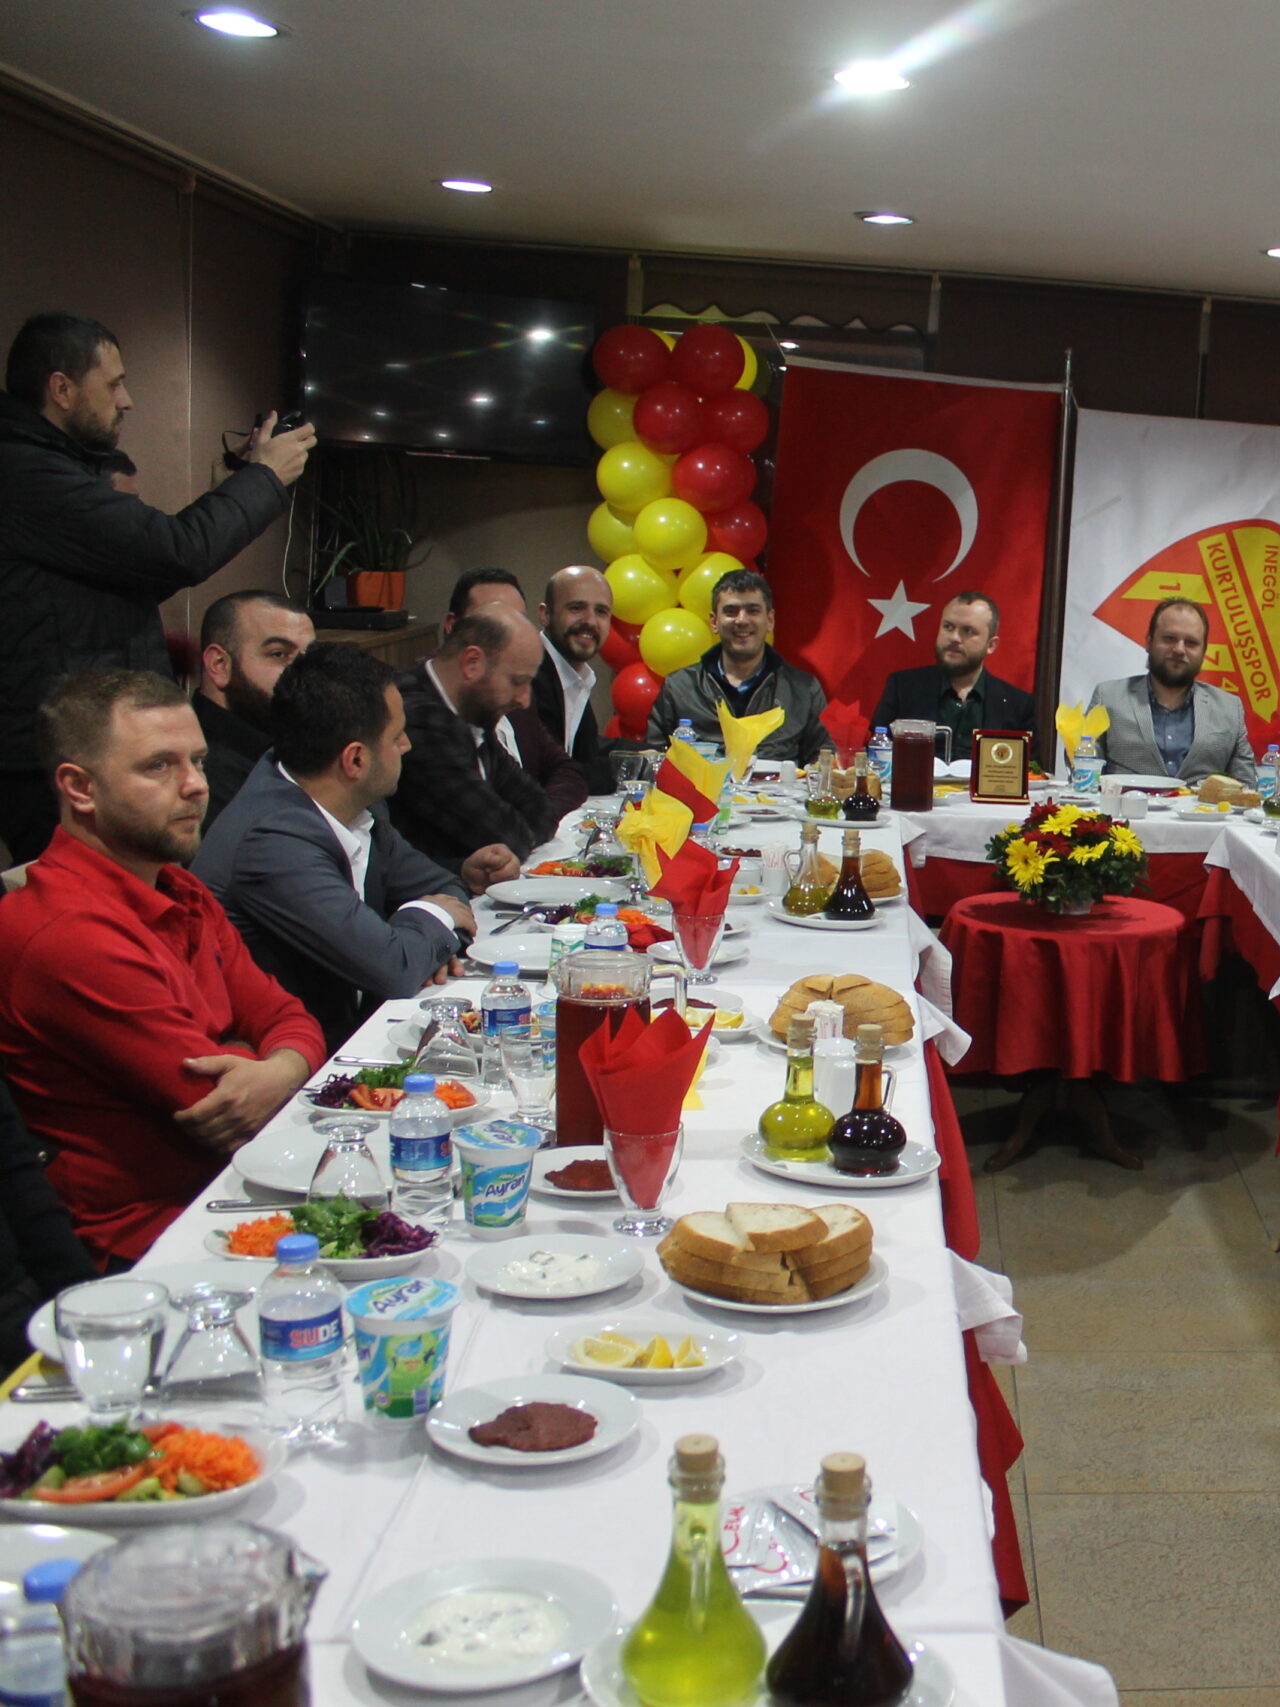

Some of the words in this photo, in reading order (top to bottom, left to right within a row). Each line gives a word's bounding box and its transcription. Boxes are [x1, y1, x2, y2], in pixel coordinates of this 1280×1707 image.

[1158, 583, 1181, 591] 1
[1206, 542, 1271, 702] KURTULUŞSPOR
[485, 1174, 526, 1198] Ayran
[372, 1280, 427, 1314] Ayran
[290, 1319, 339, 1348] SUDE
